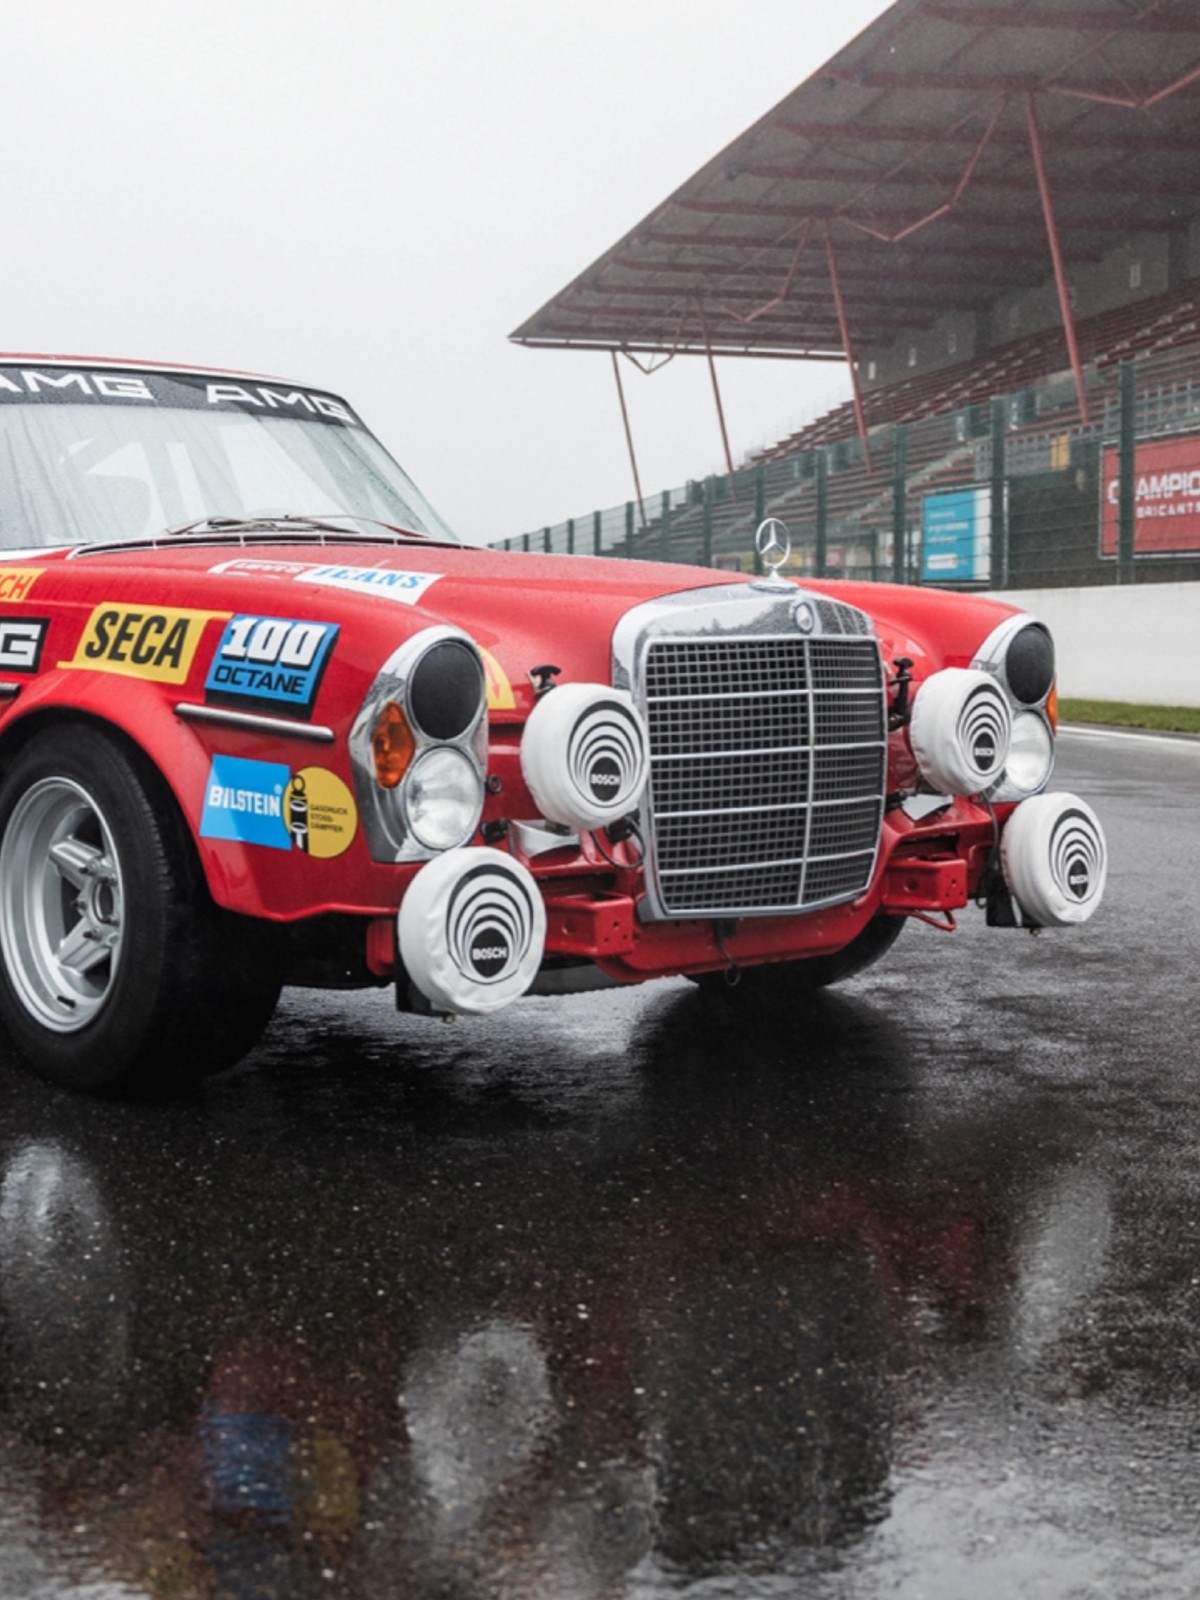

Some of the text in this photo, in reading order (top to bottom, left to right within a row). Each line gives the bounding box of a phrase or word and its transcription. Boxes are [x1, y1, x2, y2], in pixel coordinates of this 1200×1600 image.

[206, 384, 354, 424] AMG
[1108, 470, 1200, 504] CAMPIO
[314, 567, 427, 589] JEANS
[84, 610, 191, 669] SECA
[220, 615, 326, 669] 100
[213, 664, 307, 696] OCTANE
[590, 773, 621, 786] BOSCH
[208, 785, 281, 817] BILSTEIN
[472, 946, 508, 960] BOSCH
